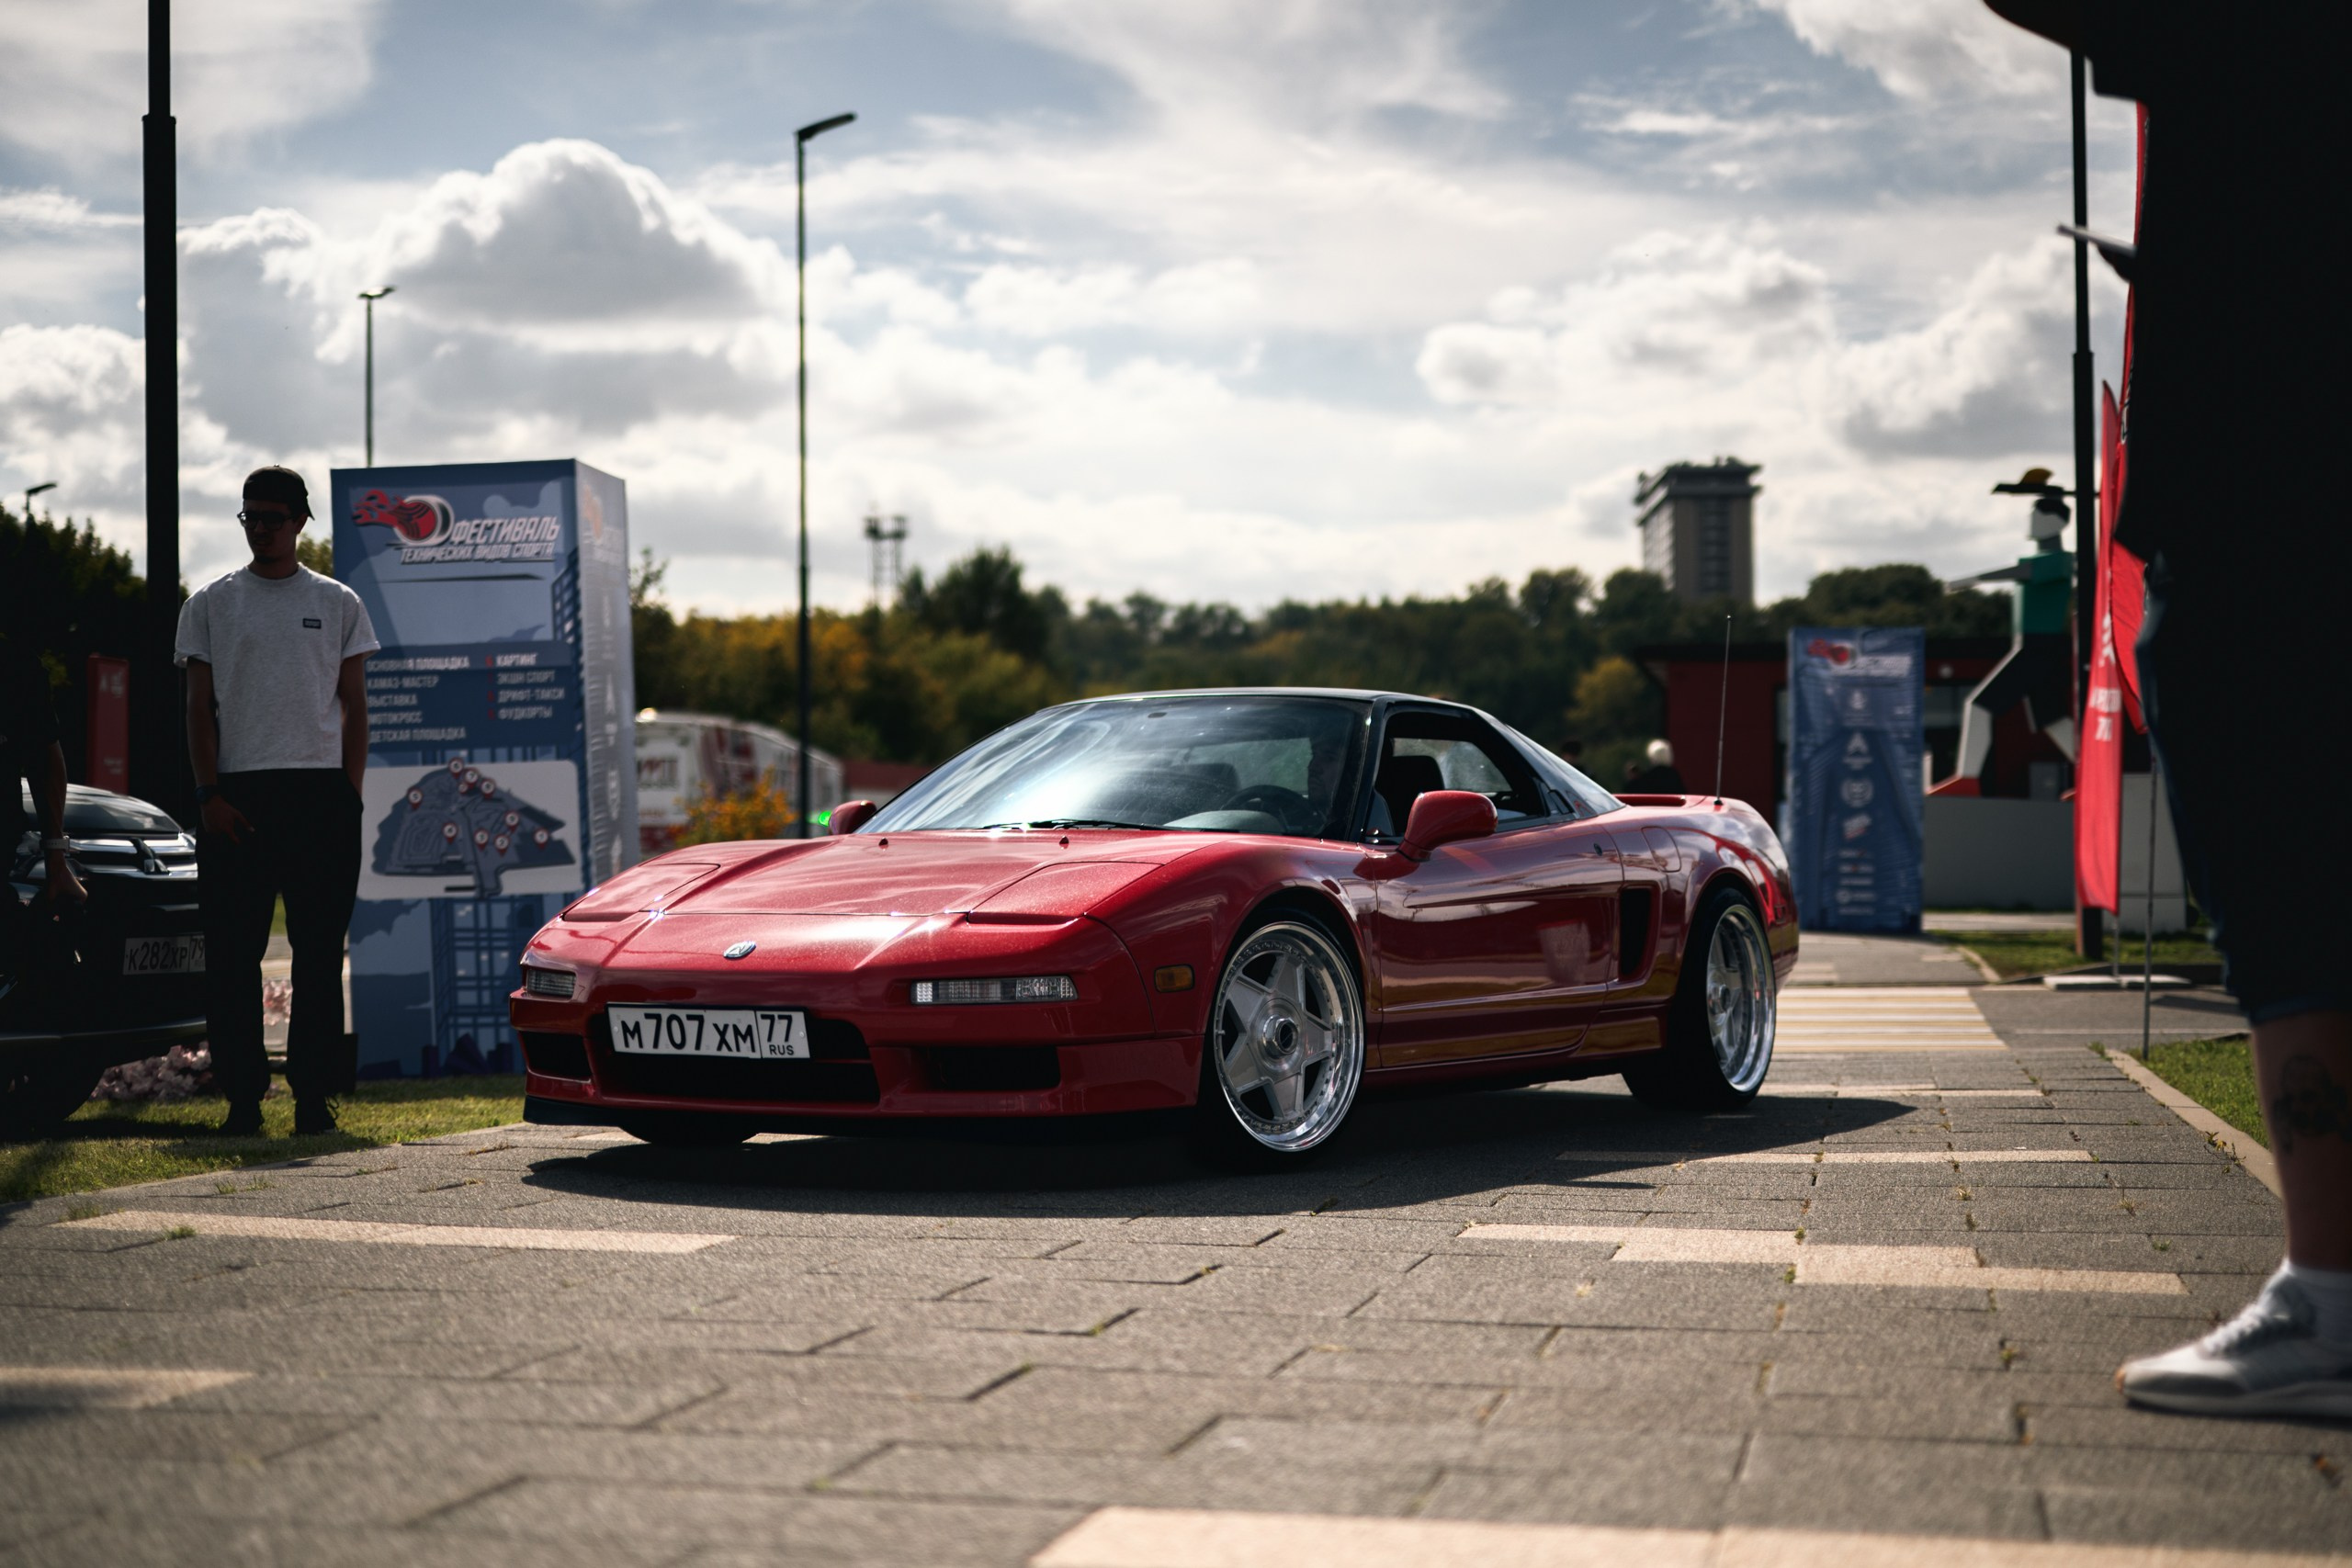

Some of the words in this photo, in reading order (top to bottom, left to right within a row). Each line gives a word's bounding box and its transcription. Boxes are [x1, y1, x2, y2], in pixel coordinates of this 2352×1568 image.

[450, 517, 560, 545] ФЕСТИВАЛЬ
[401, 546, 475, 563] ТЕХНИЧЕСКИХ
[474, 544, 512, 560] ВИДОВ
[512, 542, 555, 558] СПОРТА
[414, 656, 469, 671] ПЛОЩАДКА
[496, 653, 537, 667] КАРТИНГ
[368, 675, 439, 690] КАМАЗ-МАСТЕР
[526, 670, 556, 683] СПОРТ
[368, 694, 418, 707] ВЫСТАВКА
[498, 687, 565, 704] ДРИФТ-ТАКСИ
[368, 711, 423, 725] МОТОКРОСС
[498, 705, 553, 720] ФУДКОРТЫ
[412, 727, 467, 741] ПЛОЩАДКА
[761, 1014, 793, 1043] 77
[769, 1044, 795, 1055] RUS
